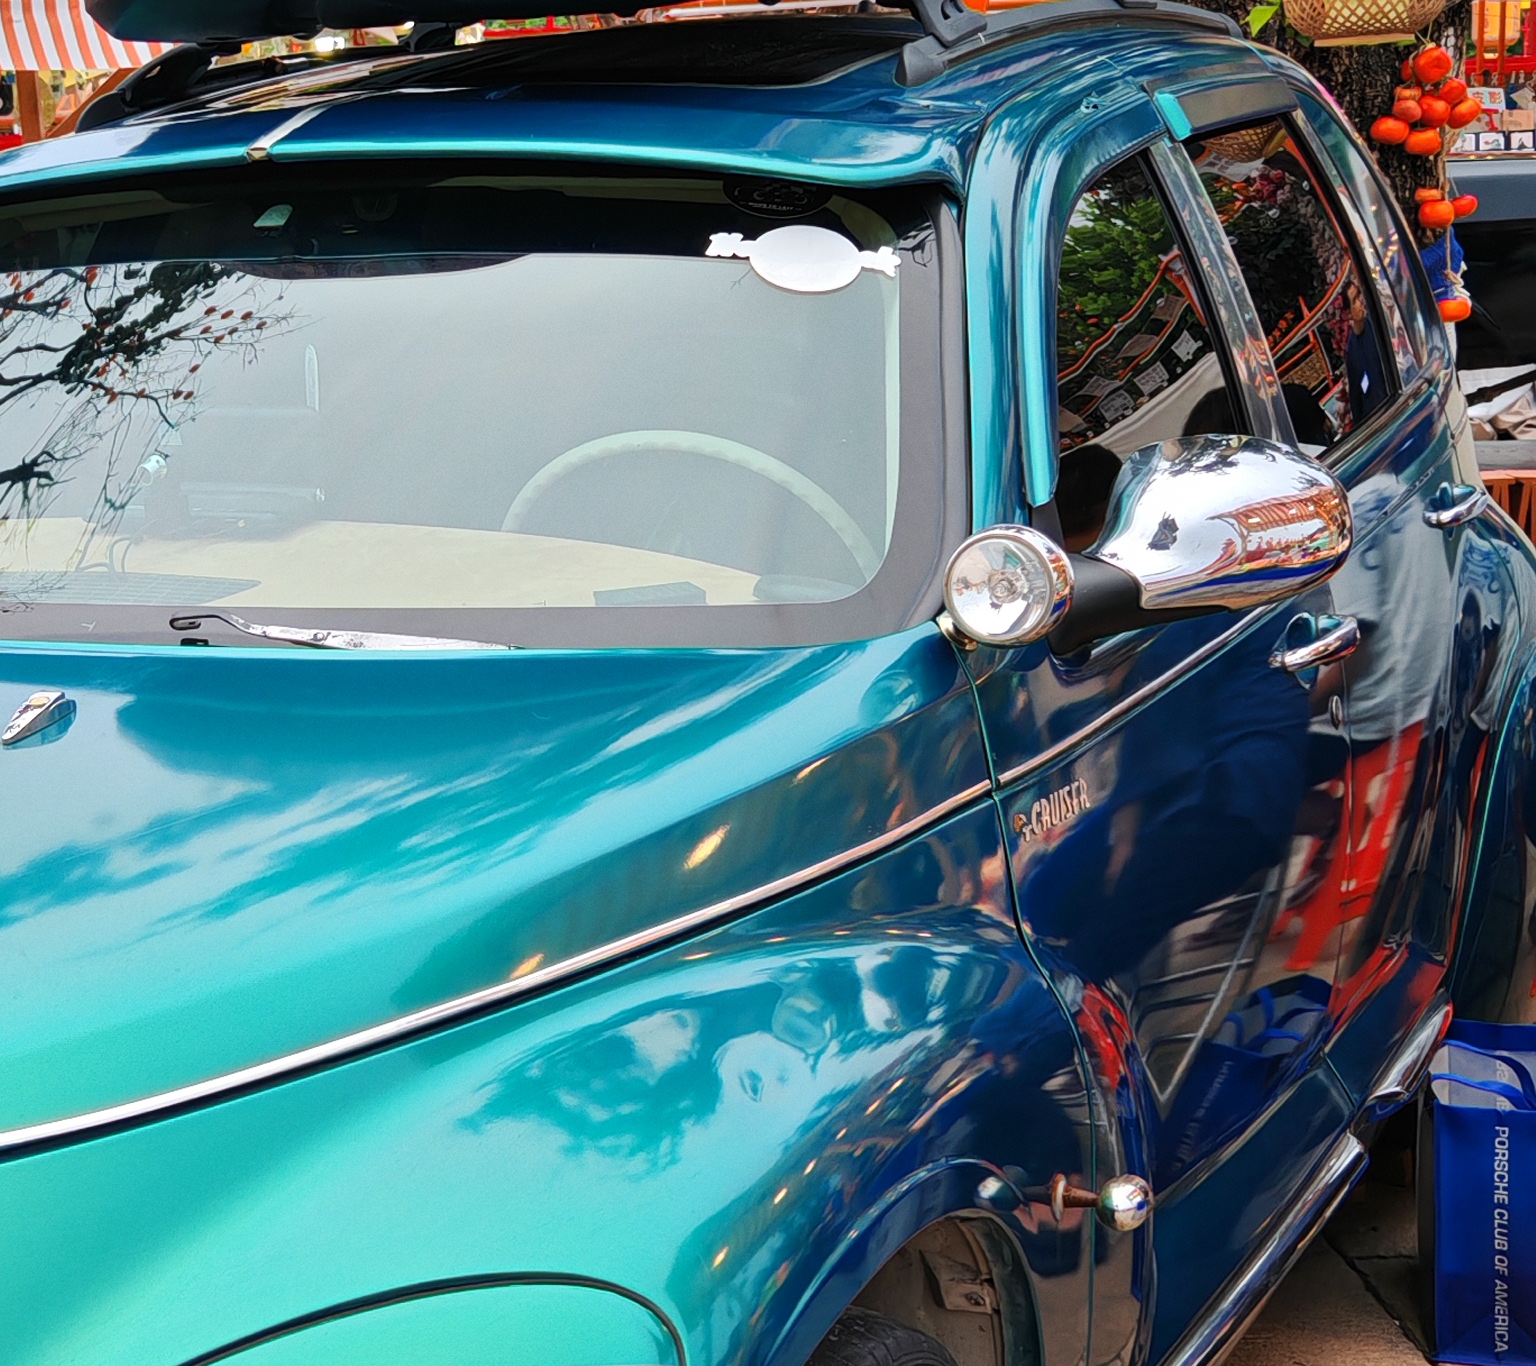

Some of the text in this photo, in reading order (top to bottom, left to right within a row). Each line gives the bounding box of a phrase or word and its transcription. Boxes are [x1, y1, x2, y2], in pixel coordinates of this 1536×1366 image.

[1031, 777, 1091, 835] CRUISER
[1494, 1126, 1509, 1205] PORSCHE
[1494, 1208, 1508, 1251] CLUB
[1495, 1255, 1508, 1276] OF
[1494, 1278, 1509, 1353] AMERICA
